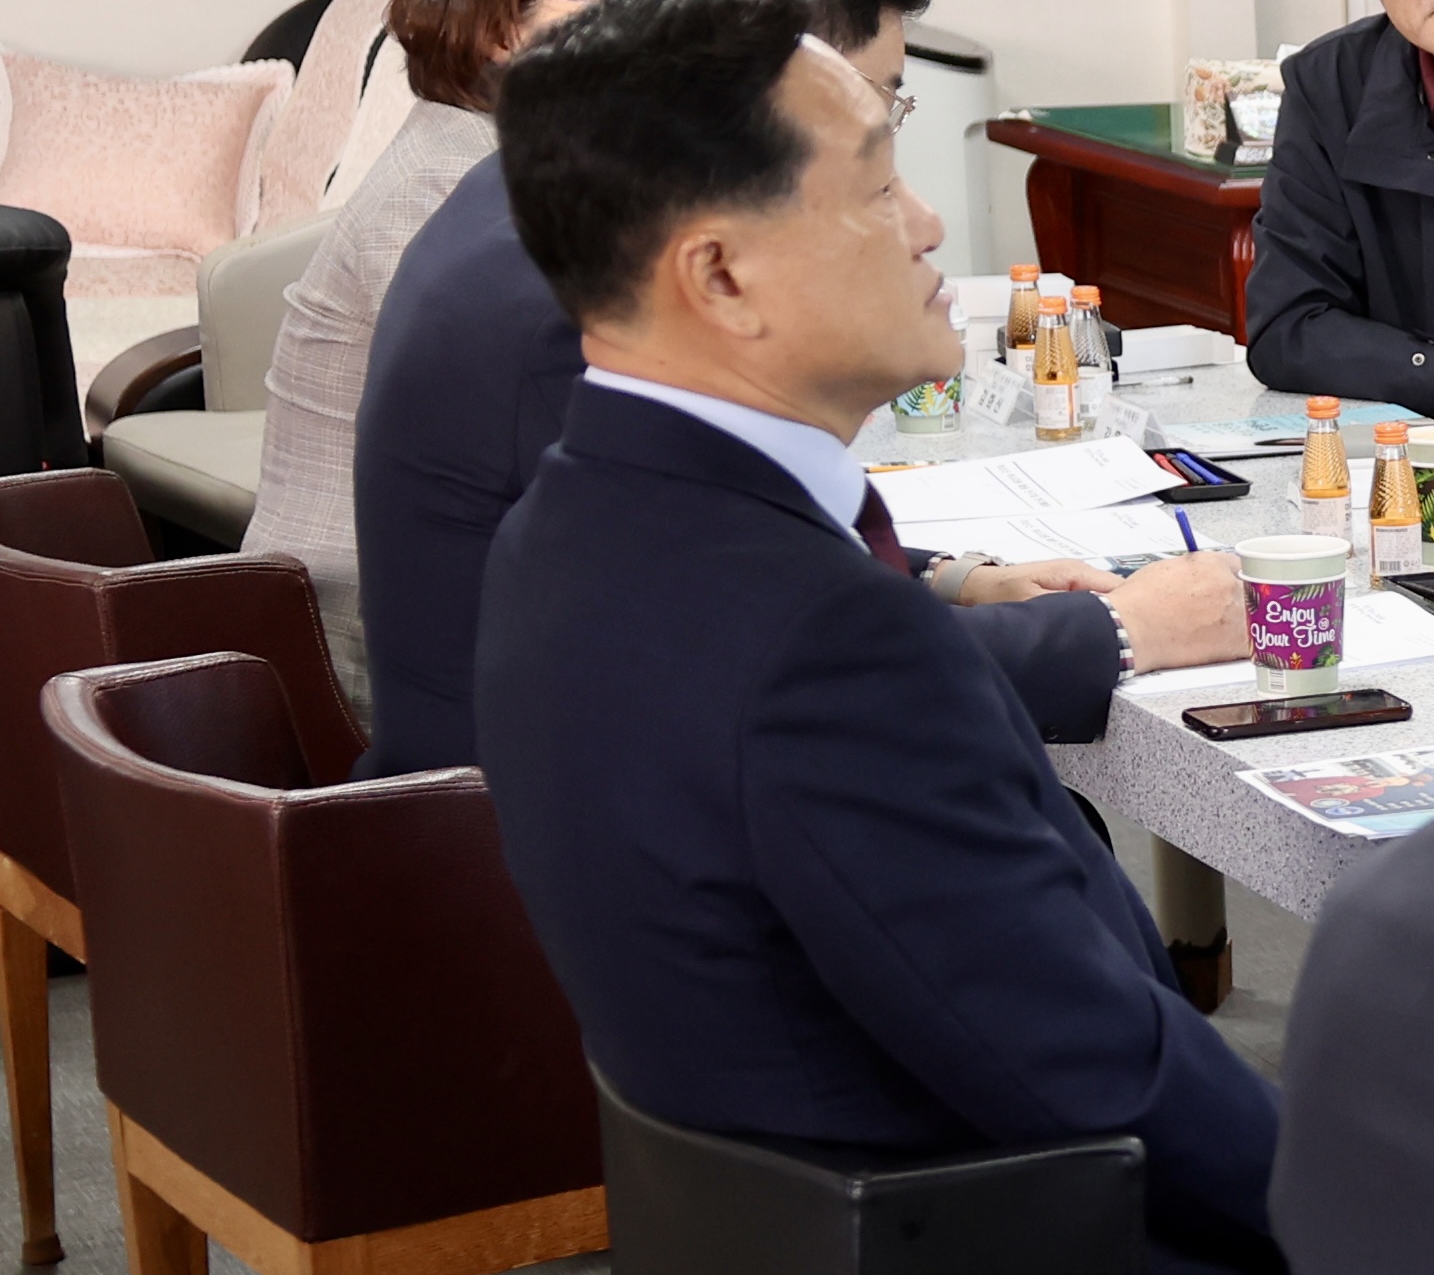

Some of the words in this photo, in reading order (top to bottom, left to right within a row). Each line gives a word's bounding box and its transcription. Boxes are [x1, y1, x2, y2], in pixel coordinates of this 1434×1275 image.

[1265, 600, 1316, 628] Enjoy
[1251, 623, 1291, 650] Your
[1292, 625, 1336, 648] Time
